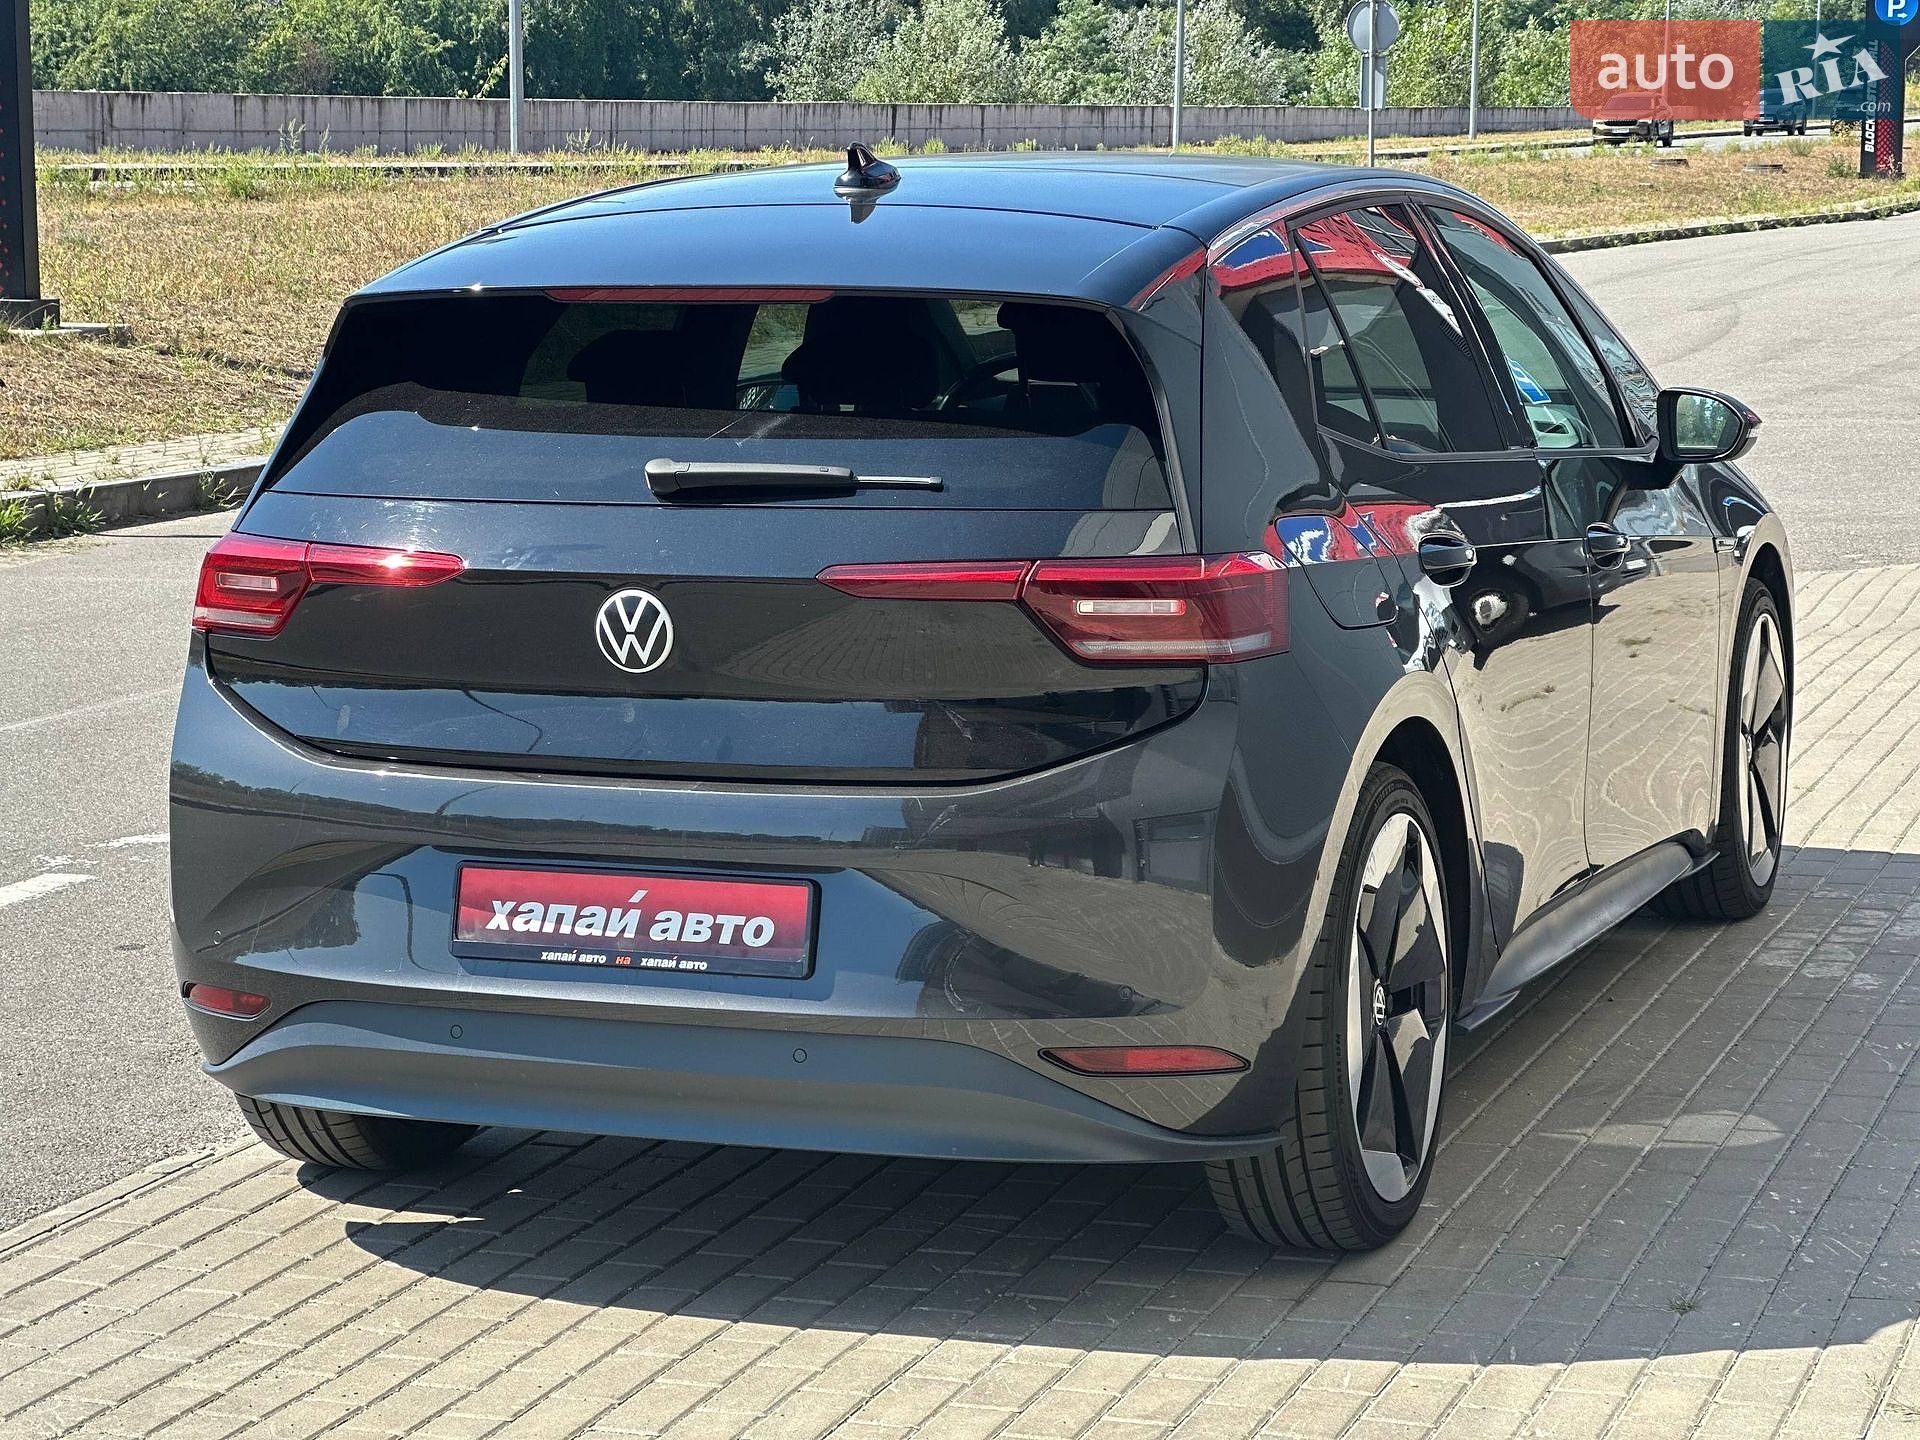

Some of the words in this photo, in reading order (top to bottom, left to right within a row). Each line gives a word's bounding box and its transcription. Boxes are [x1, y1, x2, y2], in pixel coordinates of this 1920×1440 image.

[649, 909, 775, 947] авто
[579, 953, 607, 964] авто
[616, 956, 632, 966] на
[679, 959, 708, 971] авто
